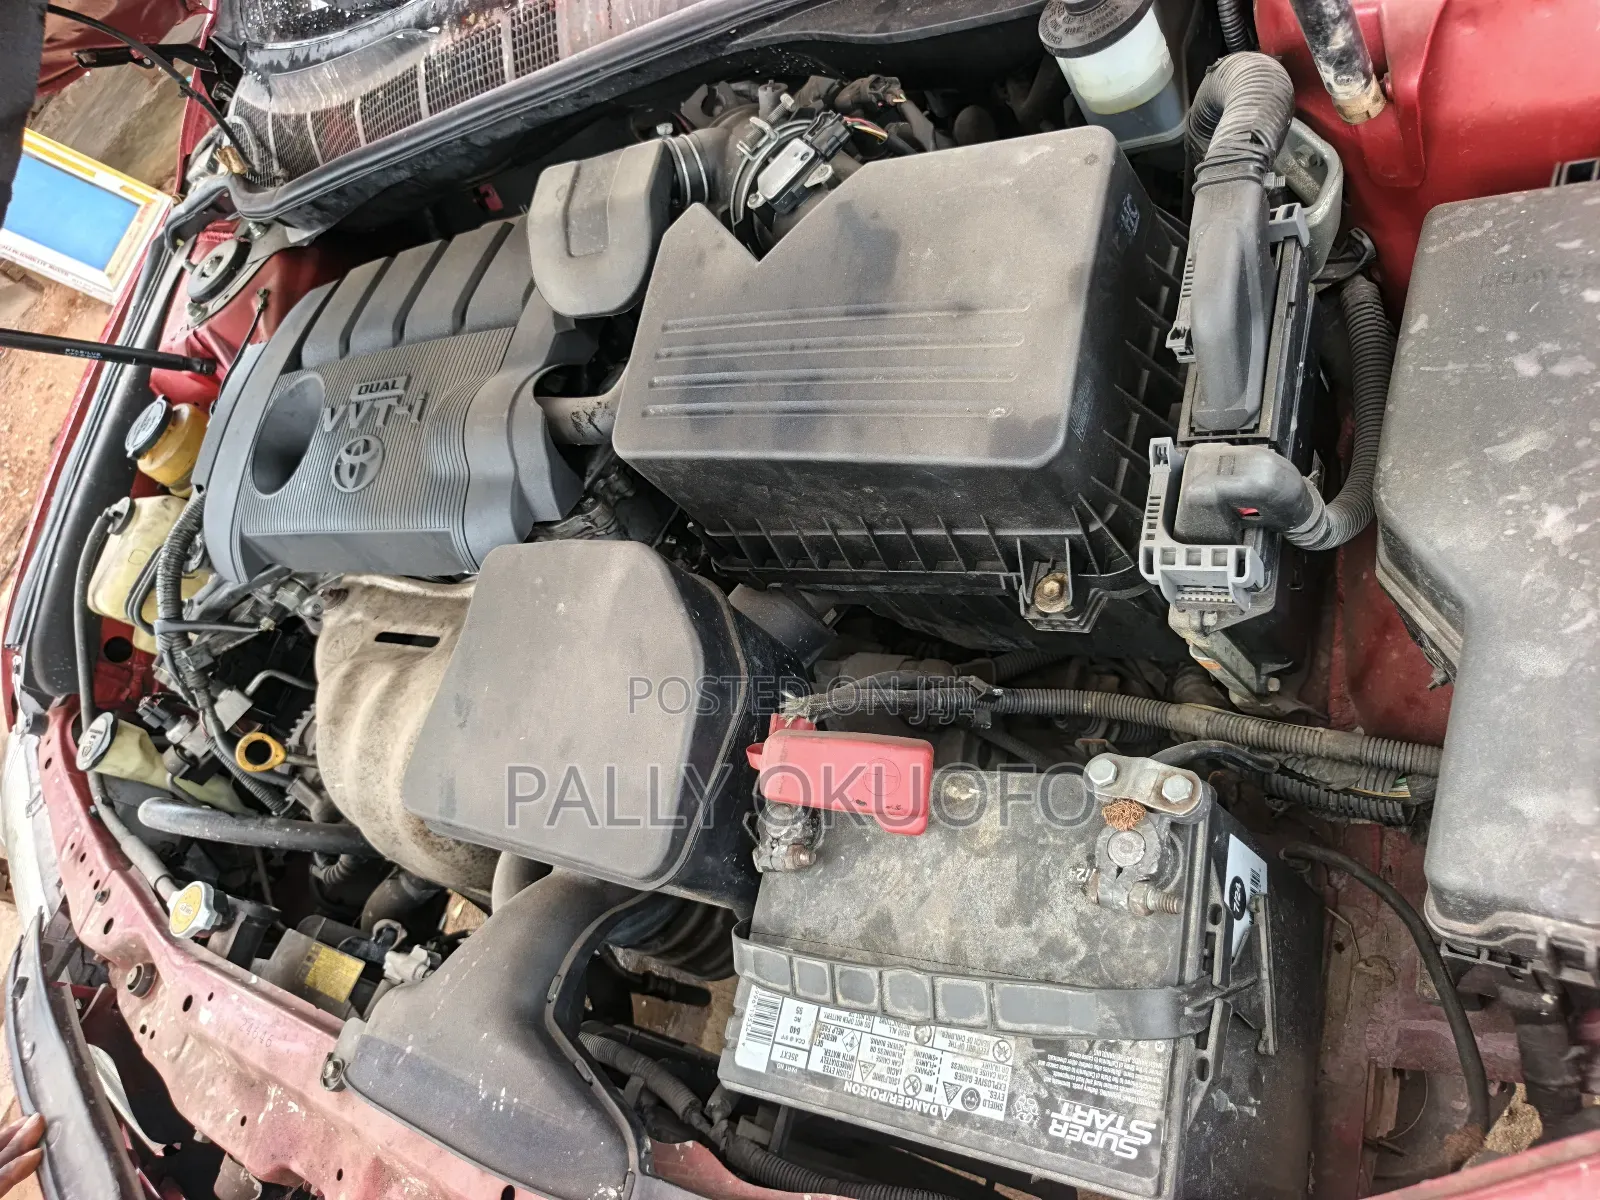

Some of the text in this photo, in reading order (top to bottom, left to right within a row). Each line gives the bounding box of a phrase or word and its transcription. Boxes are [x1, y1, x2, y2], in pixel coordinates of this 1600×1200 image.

[357, 378, 399, 395] DUAL
[788, 1024, 801, 1035] 640
[794, 1036, 805, 1044] CCA
[819, 1055, 854, 1071] IMMEDIATELY
[840, 1052, 855, 1062] WITH
[875, 1054, 891, 1064] CAUSE
[821, 1064, 852, 1078] FLUSH EYES
[885, 1066, 899, 1076] ACID
[924, 1083, 933, 1092] NO
[953, 1071, 1006, 1092] EXPLOSIVE GASES
[842, 1079, 939, 1116] DANGER/POISON
[981, 1098, 1004, 1111] SHIELD
[1050, 1101, 1157, 1146] START
[1049, 1119, 1139, 1160] SUPER
